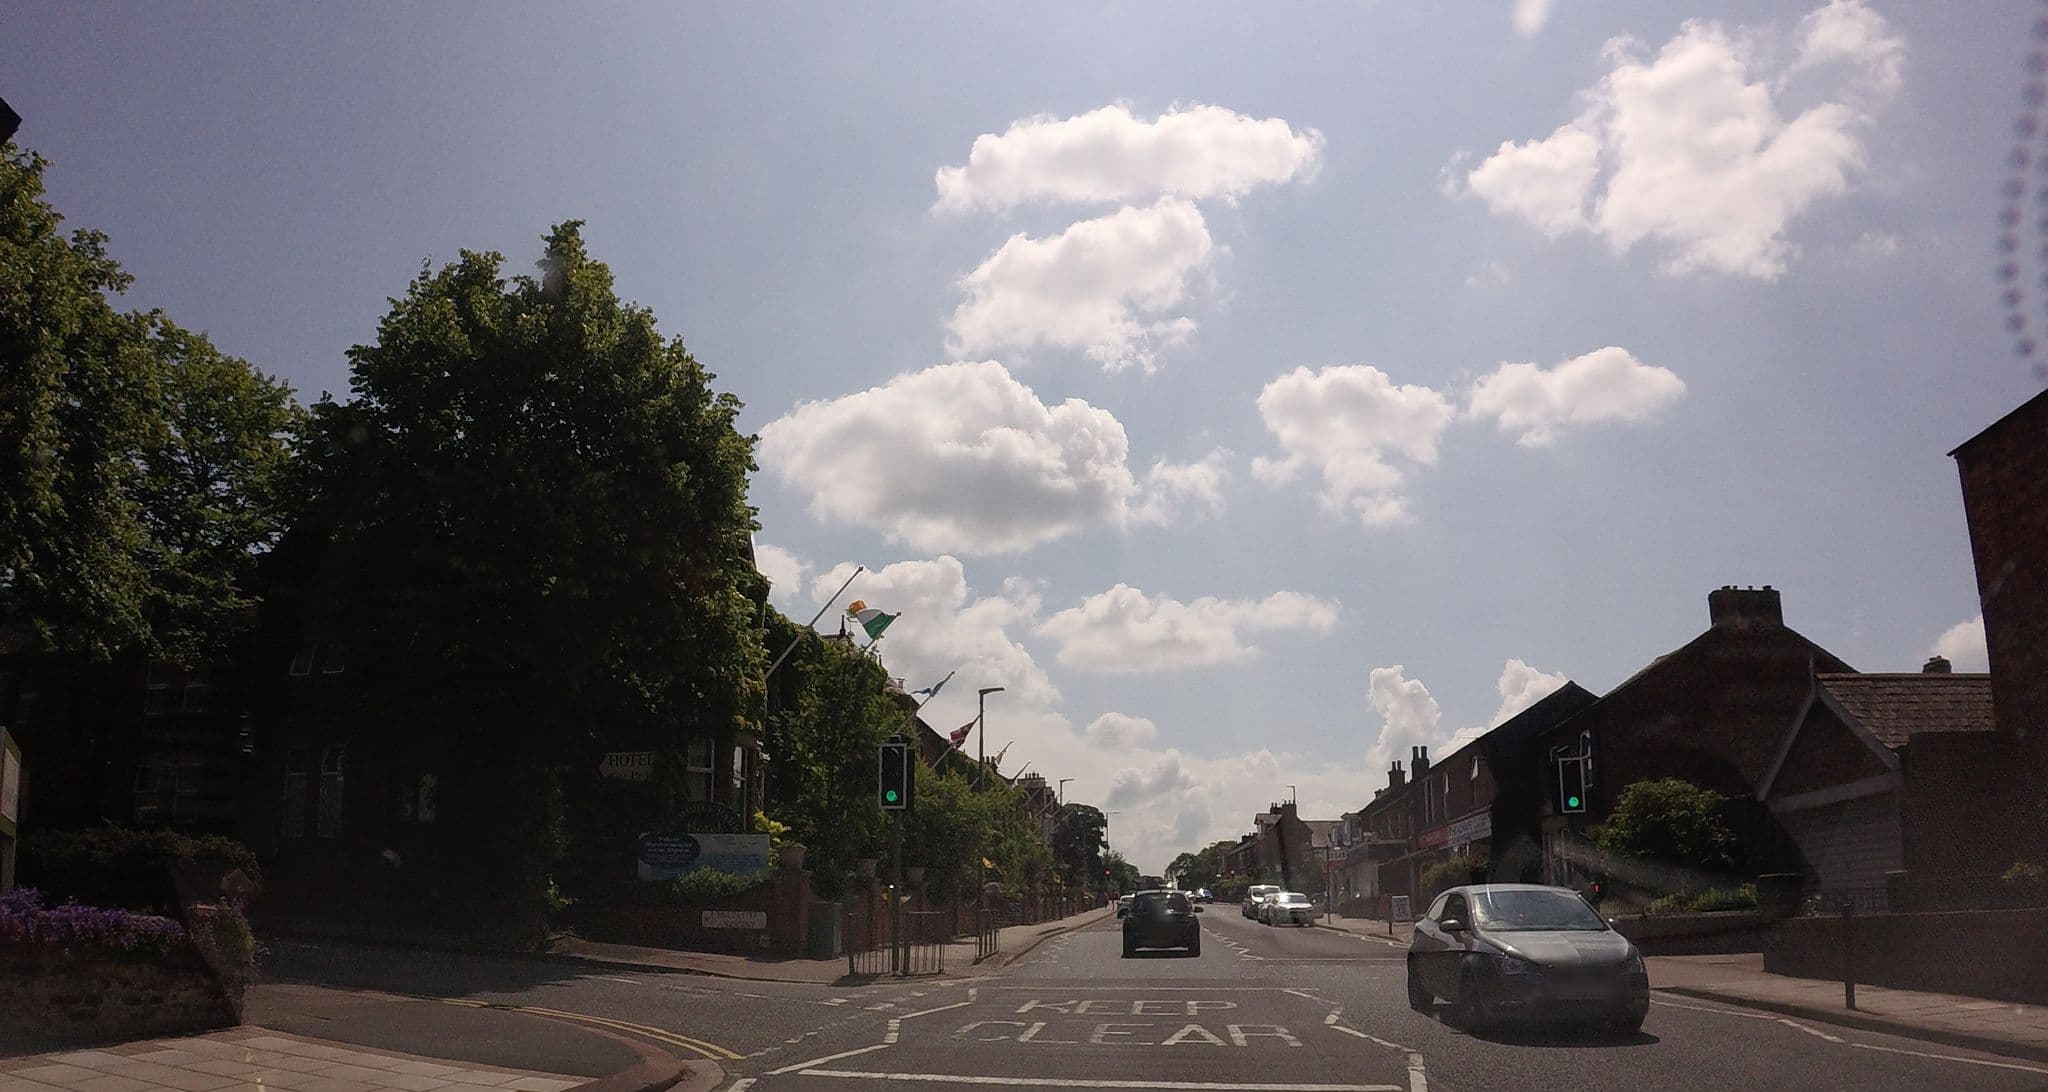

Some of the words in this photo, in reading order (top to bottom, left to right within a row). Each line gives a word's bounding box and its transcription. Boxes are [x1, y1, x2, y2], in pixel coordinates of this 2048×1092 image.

[607, 752, 653, 767] HOTEL
[1015, 1000, 1238, 1016] KEEP
[950, 1020, 1303, 1047] CLEAR
